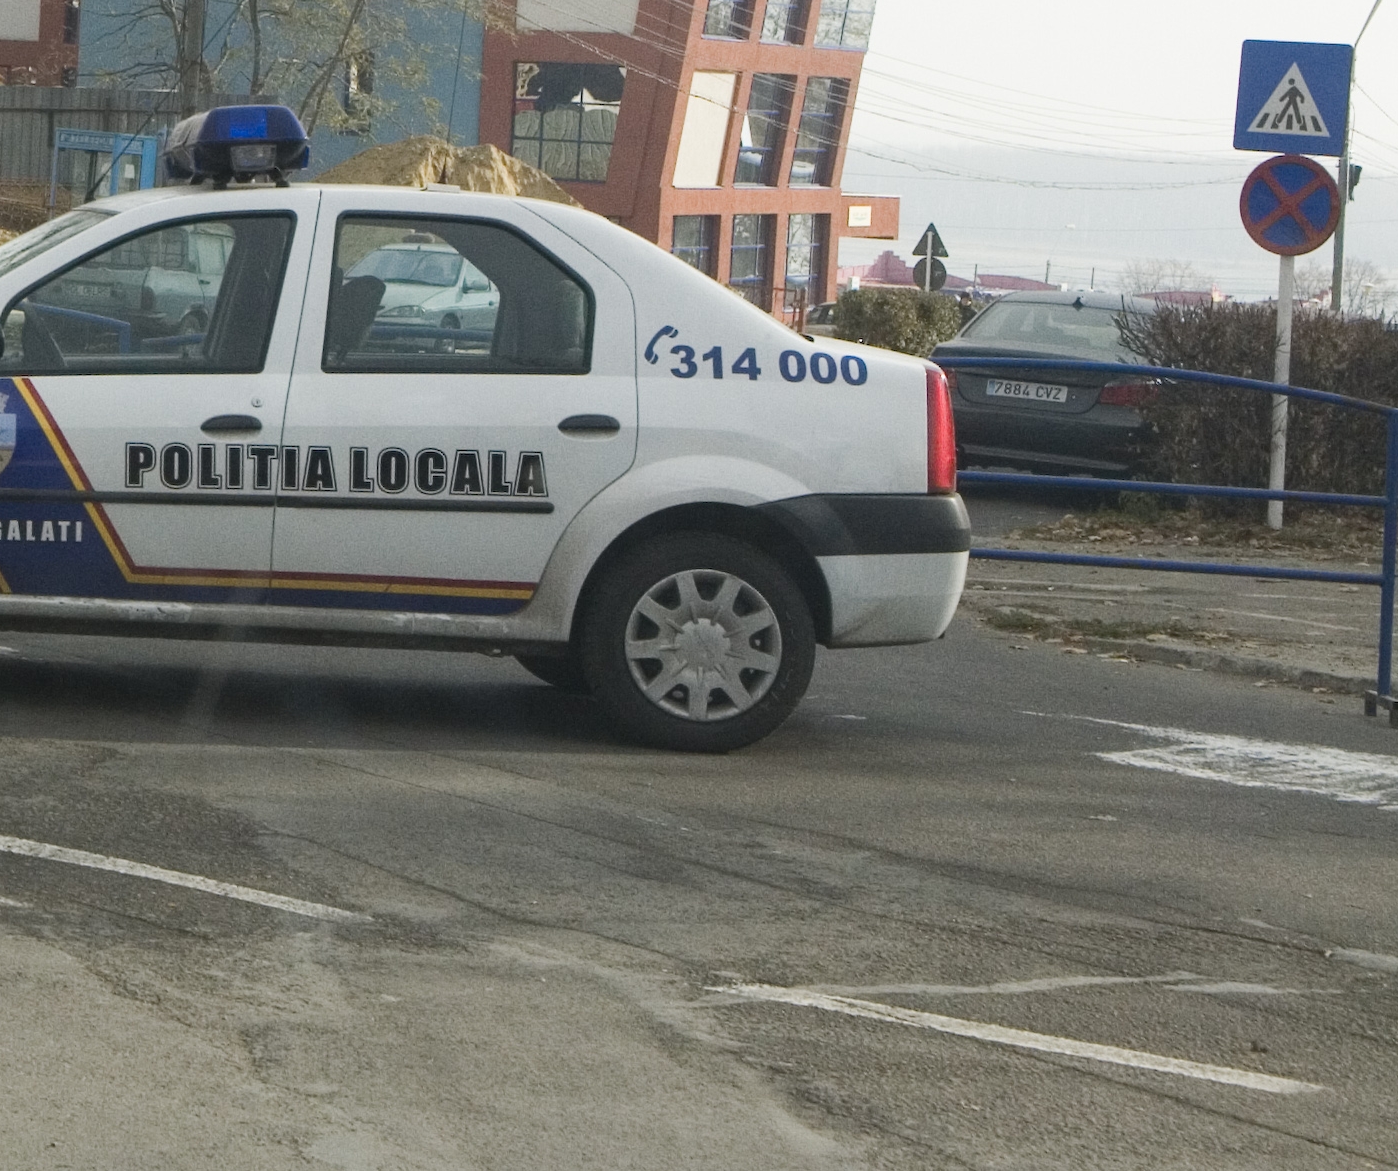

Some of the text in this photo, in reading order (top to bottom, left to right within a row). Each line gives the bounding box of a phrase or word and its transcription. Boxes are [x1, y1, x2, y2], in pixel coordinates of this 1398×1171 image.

[670, 345, 868, 386] 314 000
[994, 381, 1062, 400] 7884 CVZ
[125, 442, 549, 498] POLITIA LOCALA
